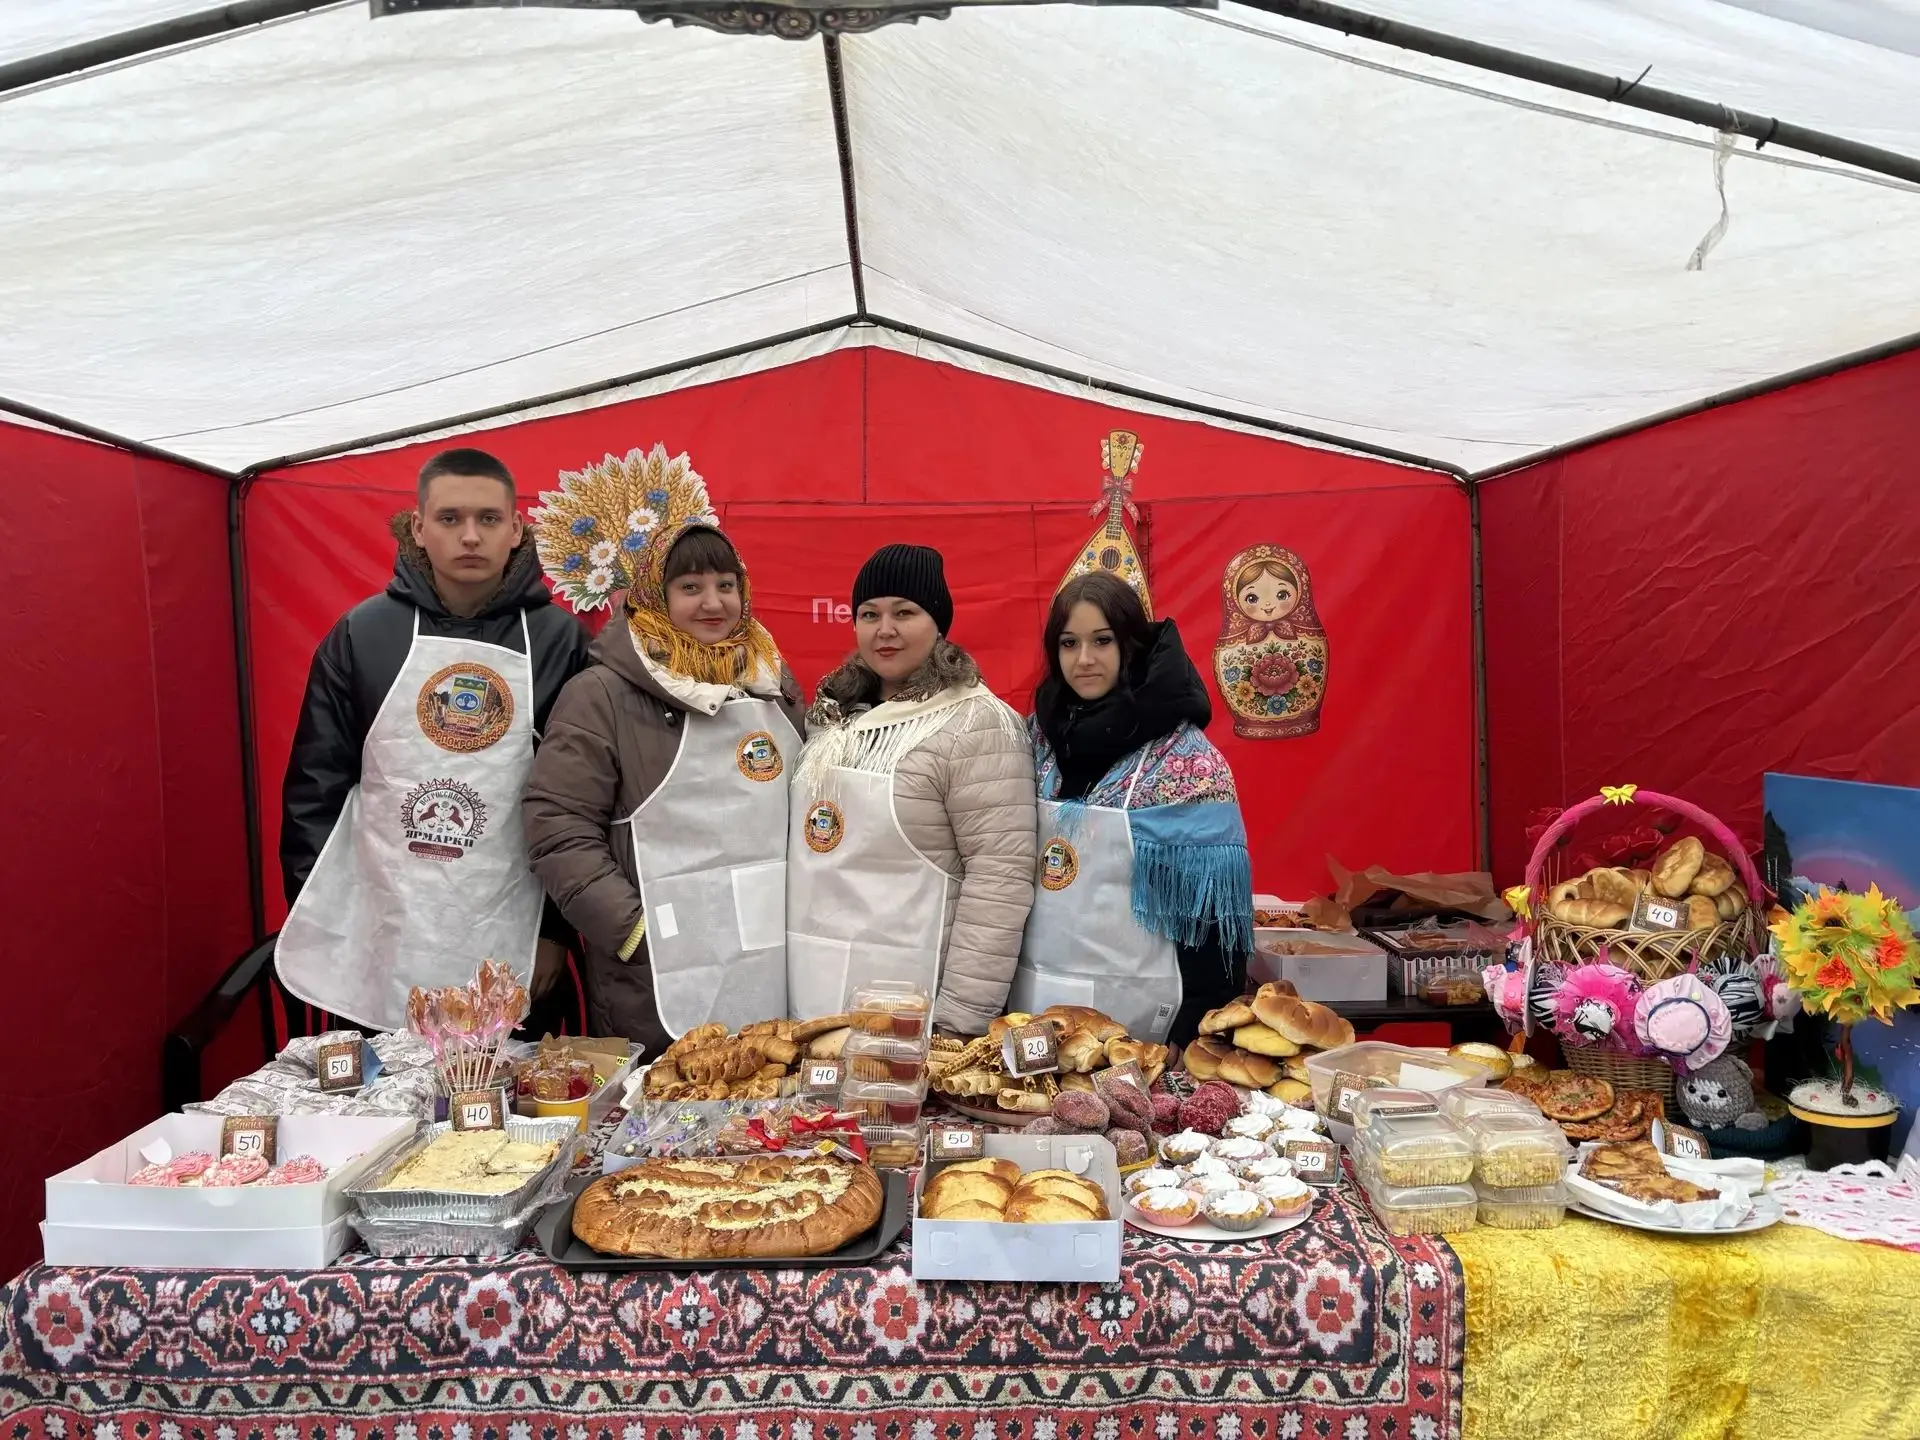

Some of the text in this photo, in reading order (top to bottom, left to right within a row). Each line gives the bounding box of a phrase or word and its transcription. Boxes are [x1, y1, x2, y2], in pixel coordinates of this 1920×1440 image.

[812, 598, 854, 625] Пе
[423, 713, 505, 749] НОВОПОКРОВСКАЯ
[405, 830, 474, 847] ЯРМАРКИ
[1652, 908, 1673, 923] 40
[1027, 1040, 1045, 1056] 20
[331, 1059, 348, 1075] 50
[815, 1069, 836, 1081] 40
[467, 1106, 489, 1122] 40
[238, 1134, 261, 1151] 50
[948, 1133, 970, 1145] 50
[1300, 1155, 1320, 1167] 30
